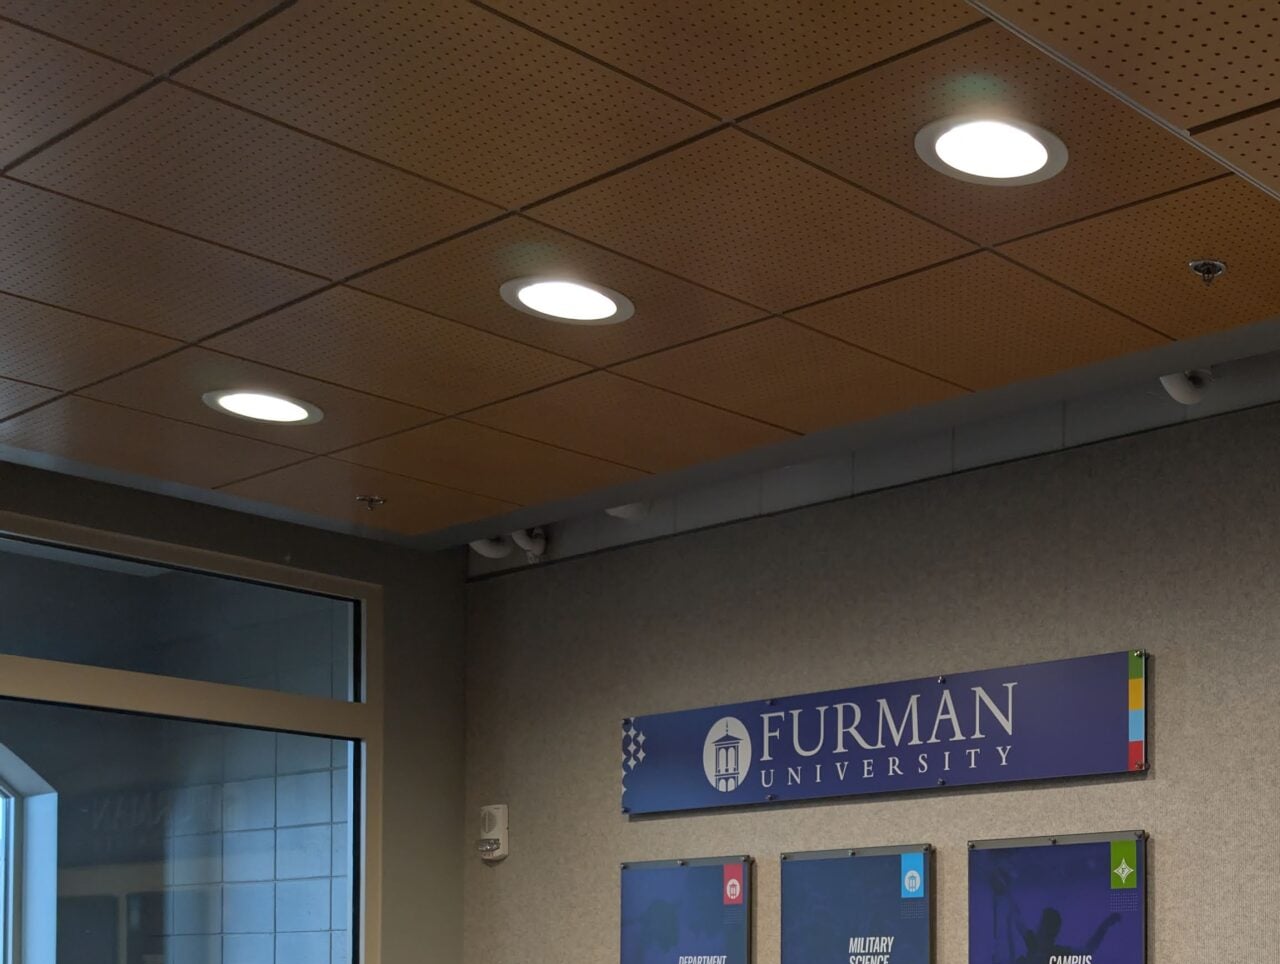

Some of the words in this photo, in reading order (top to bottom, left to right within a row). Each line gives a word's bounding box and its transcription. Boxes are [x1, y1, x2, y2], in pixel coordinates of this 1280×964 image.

[759, 682, 1017, 761] FURMAN
[762, 746, 1011, 789] UNIVERSITY
[849, 936, 894, 953] MILITARY
